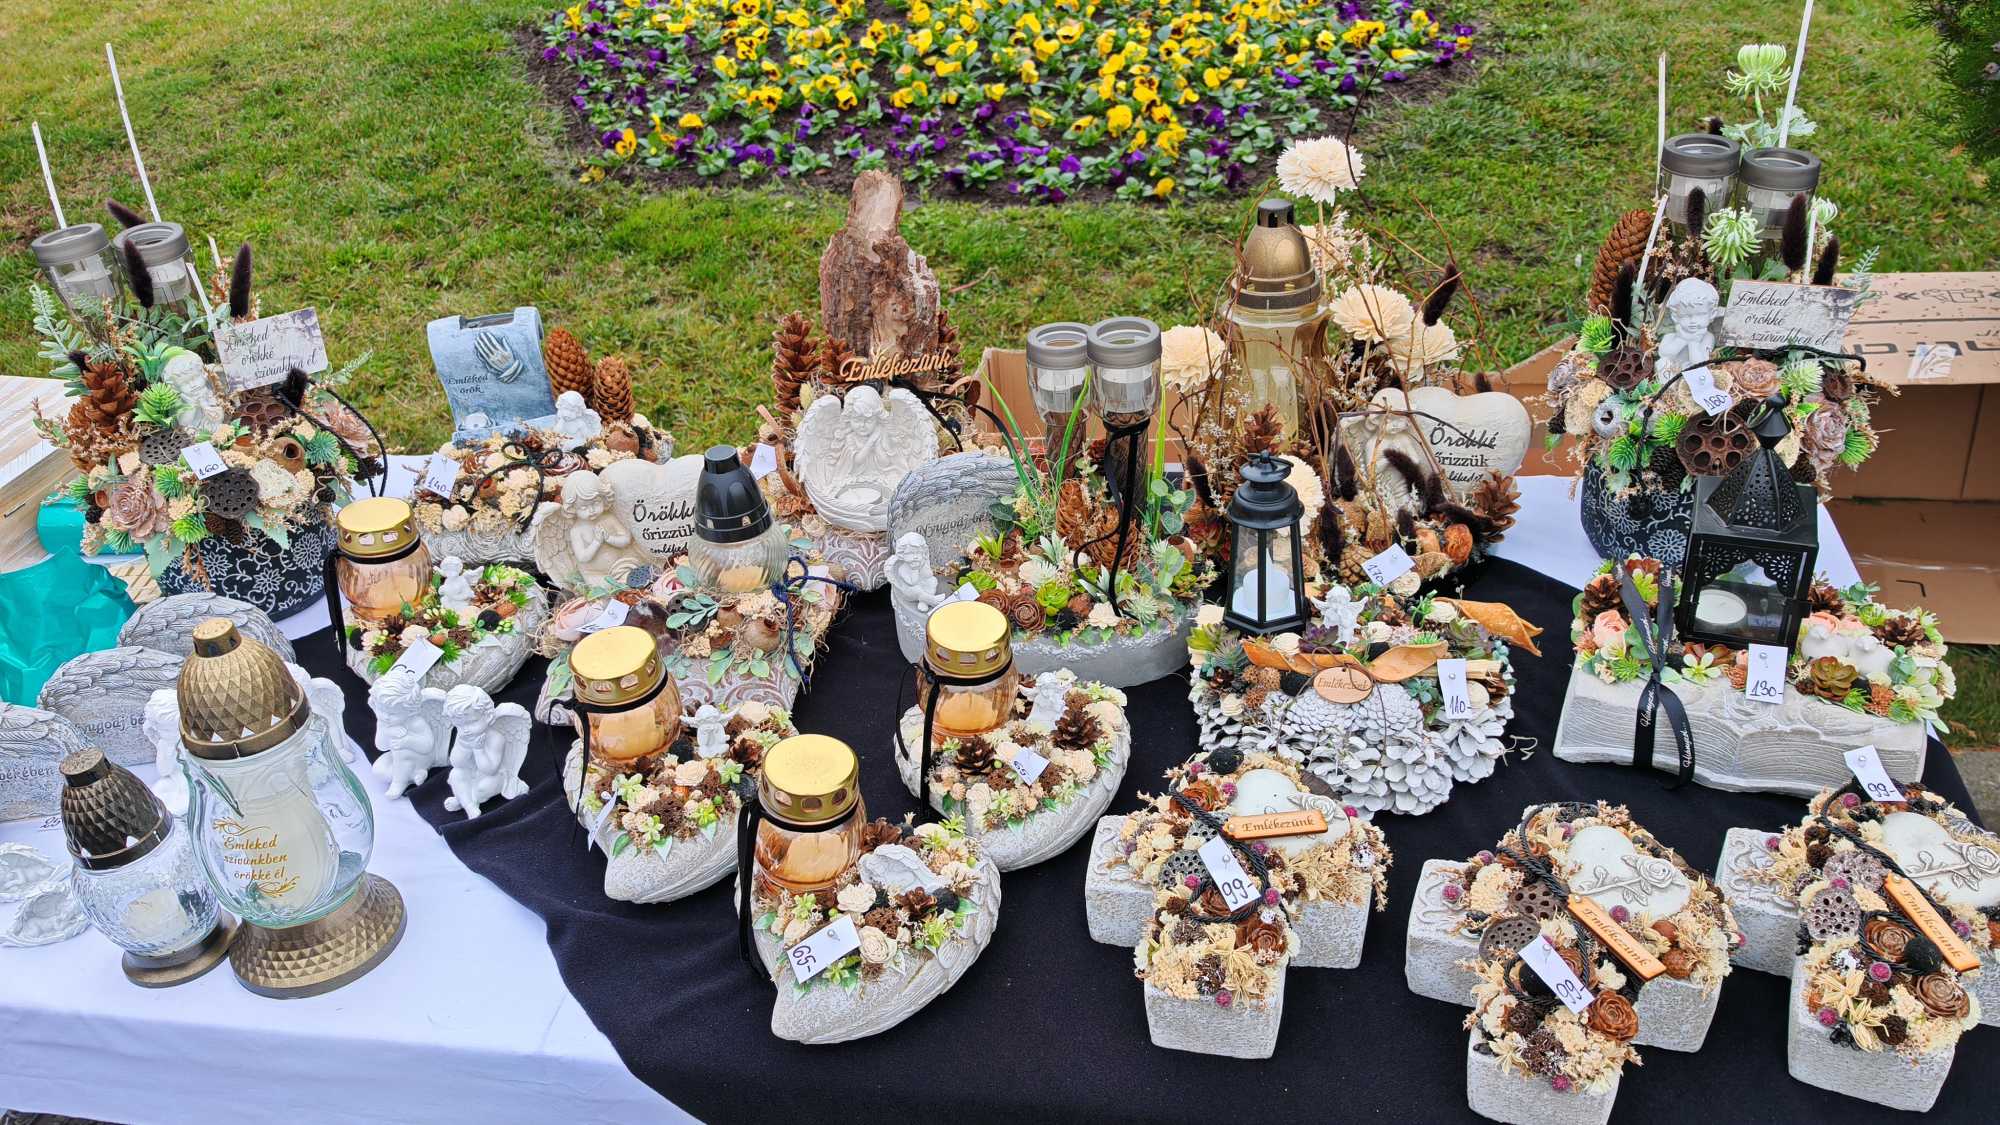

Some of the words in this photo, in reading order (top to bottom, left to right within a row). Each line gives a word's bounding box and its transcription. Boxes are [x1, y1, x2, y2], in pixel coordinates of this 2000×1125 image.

[1429, 422, 1499, 449] Örökké
[632, 499, 696, 523] Örökk
[1749, 679, 1783, 697] 130-
[1867, 782, 1896, 798] 99-
[1241, 815, 1316, 833] Emlékezünk
[1221, 877, 1254, 905] 99-
[792, 944, 817, 974] 65-
[1555, 979, 1586, 1005] 99-
